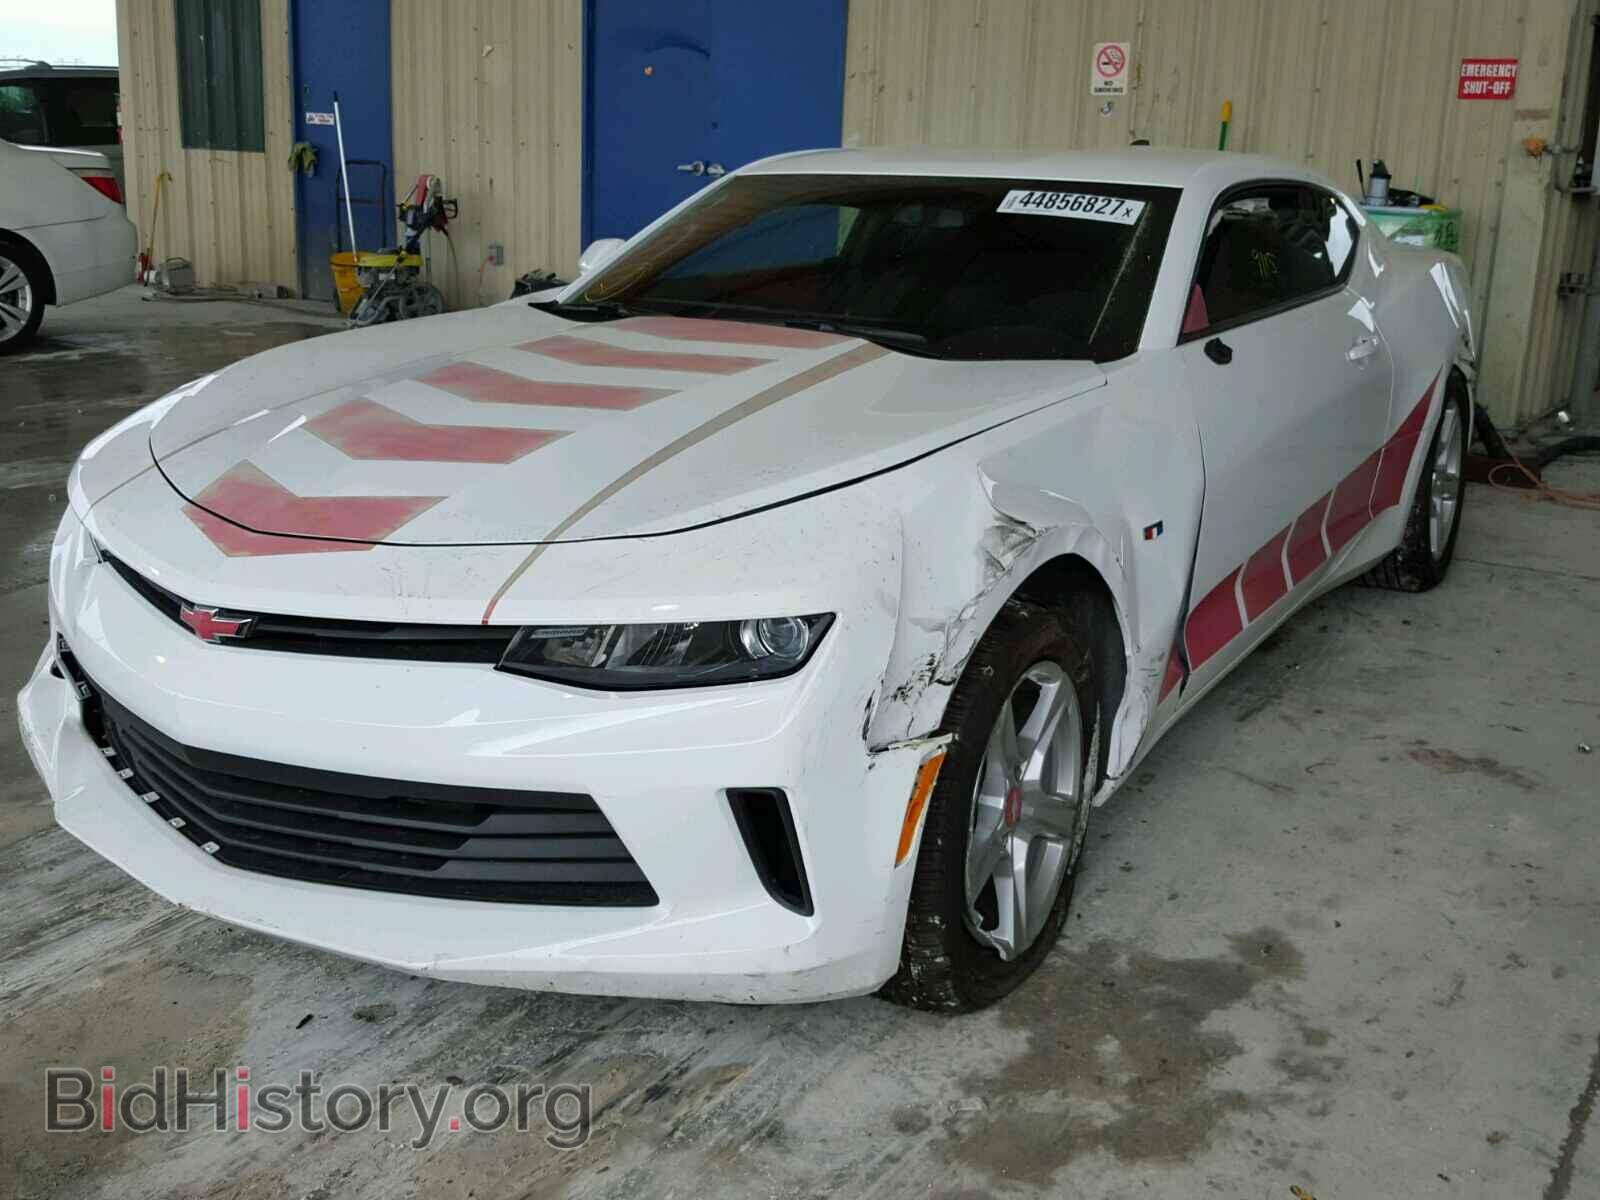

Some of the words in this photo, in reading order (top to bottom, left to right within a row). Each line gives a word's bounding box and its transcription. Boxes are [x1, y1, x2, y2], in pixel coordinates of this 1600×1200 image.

[1461, 63, 1518, 77] EMERGENCY
[1463, 80, 1511, 95] SHUT-OFF
[1019, 191, 1125, 216] 44856827
